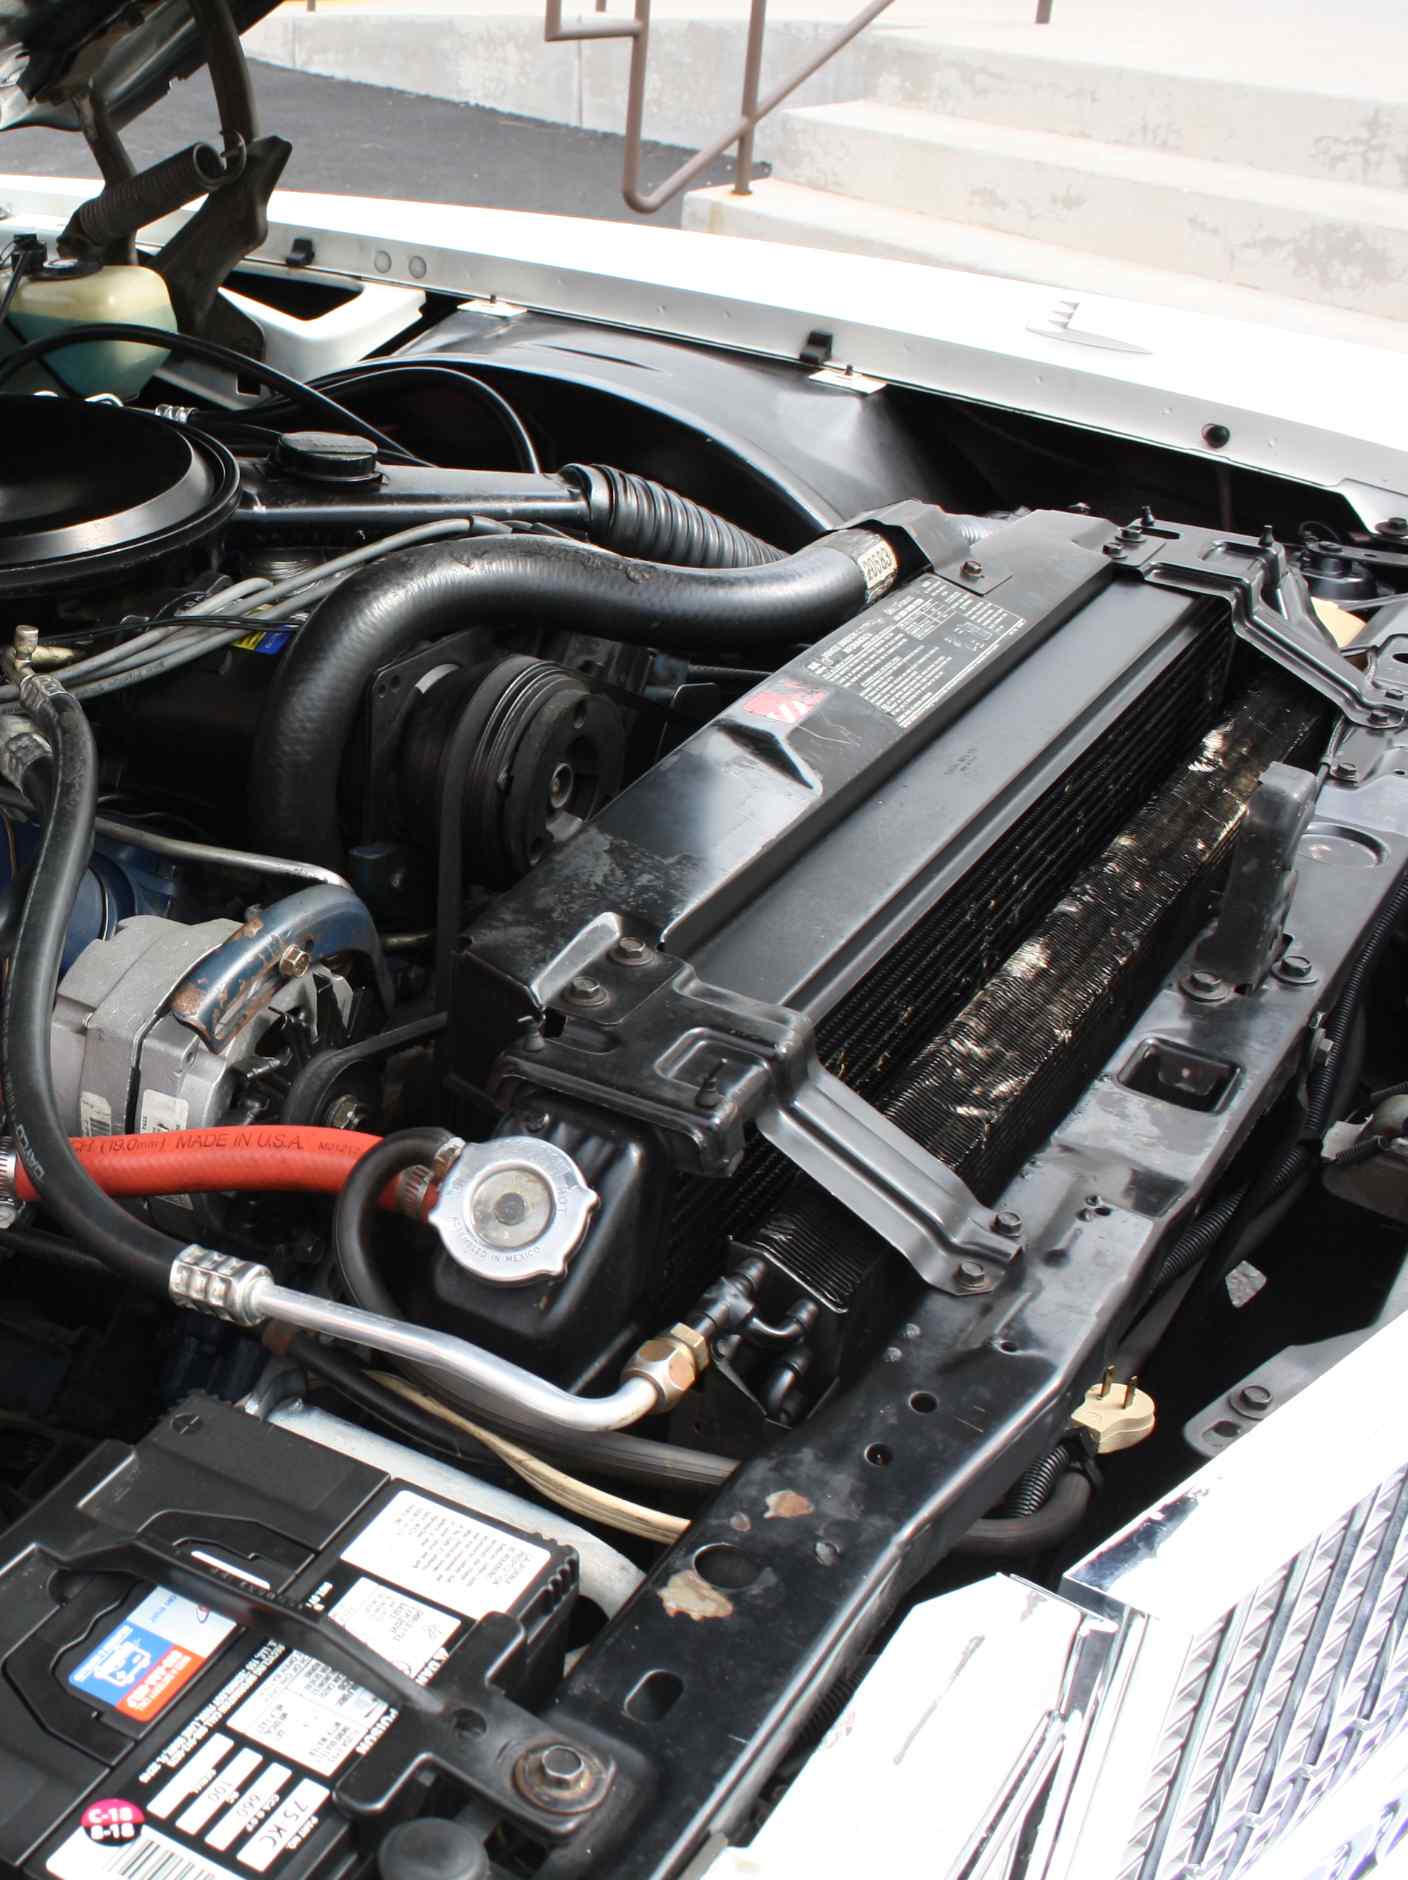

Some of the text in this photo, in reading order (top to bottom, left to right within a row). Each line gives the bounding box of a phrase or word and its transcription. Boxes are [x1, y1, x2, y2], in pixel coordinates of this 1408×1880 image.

[176, 1134, 227, 1150] MADE
[233, 1132, 250, 1148] IN
[504, 1245, 542, 1264] MEXICO
[205, 1777, 233, 1803] 100
[257, 1797, 310, 1850] 75 KC
